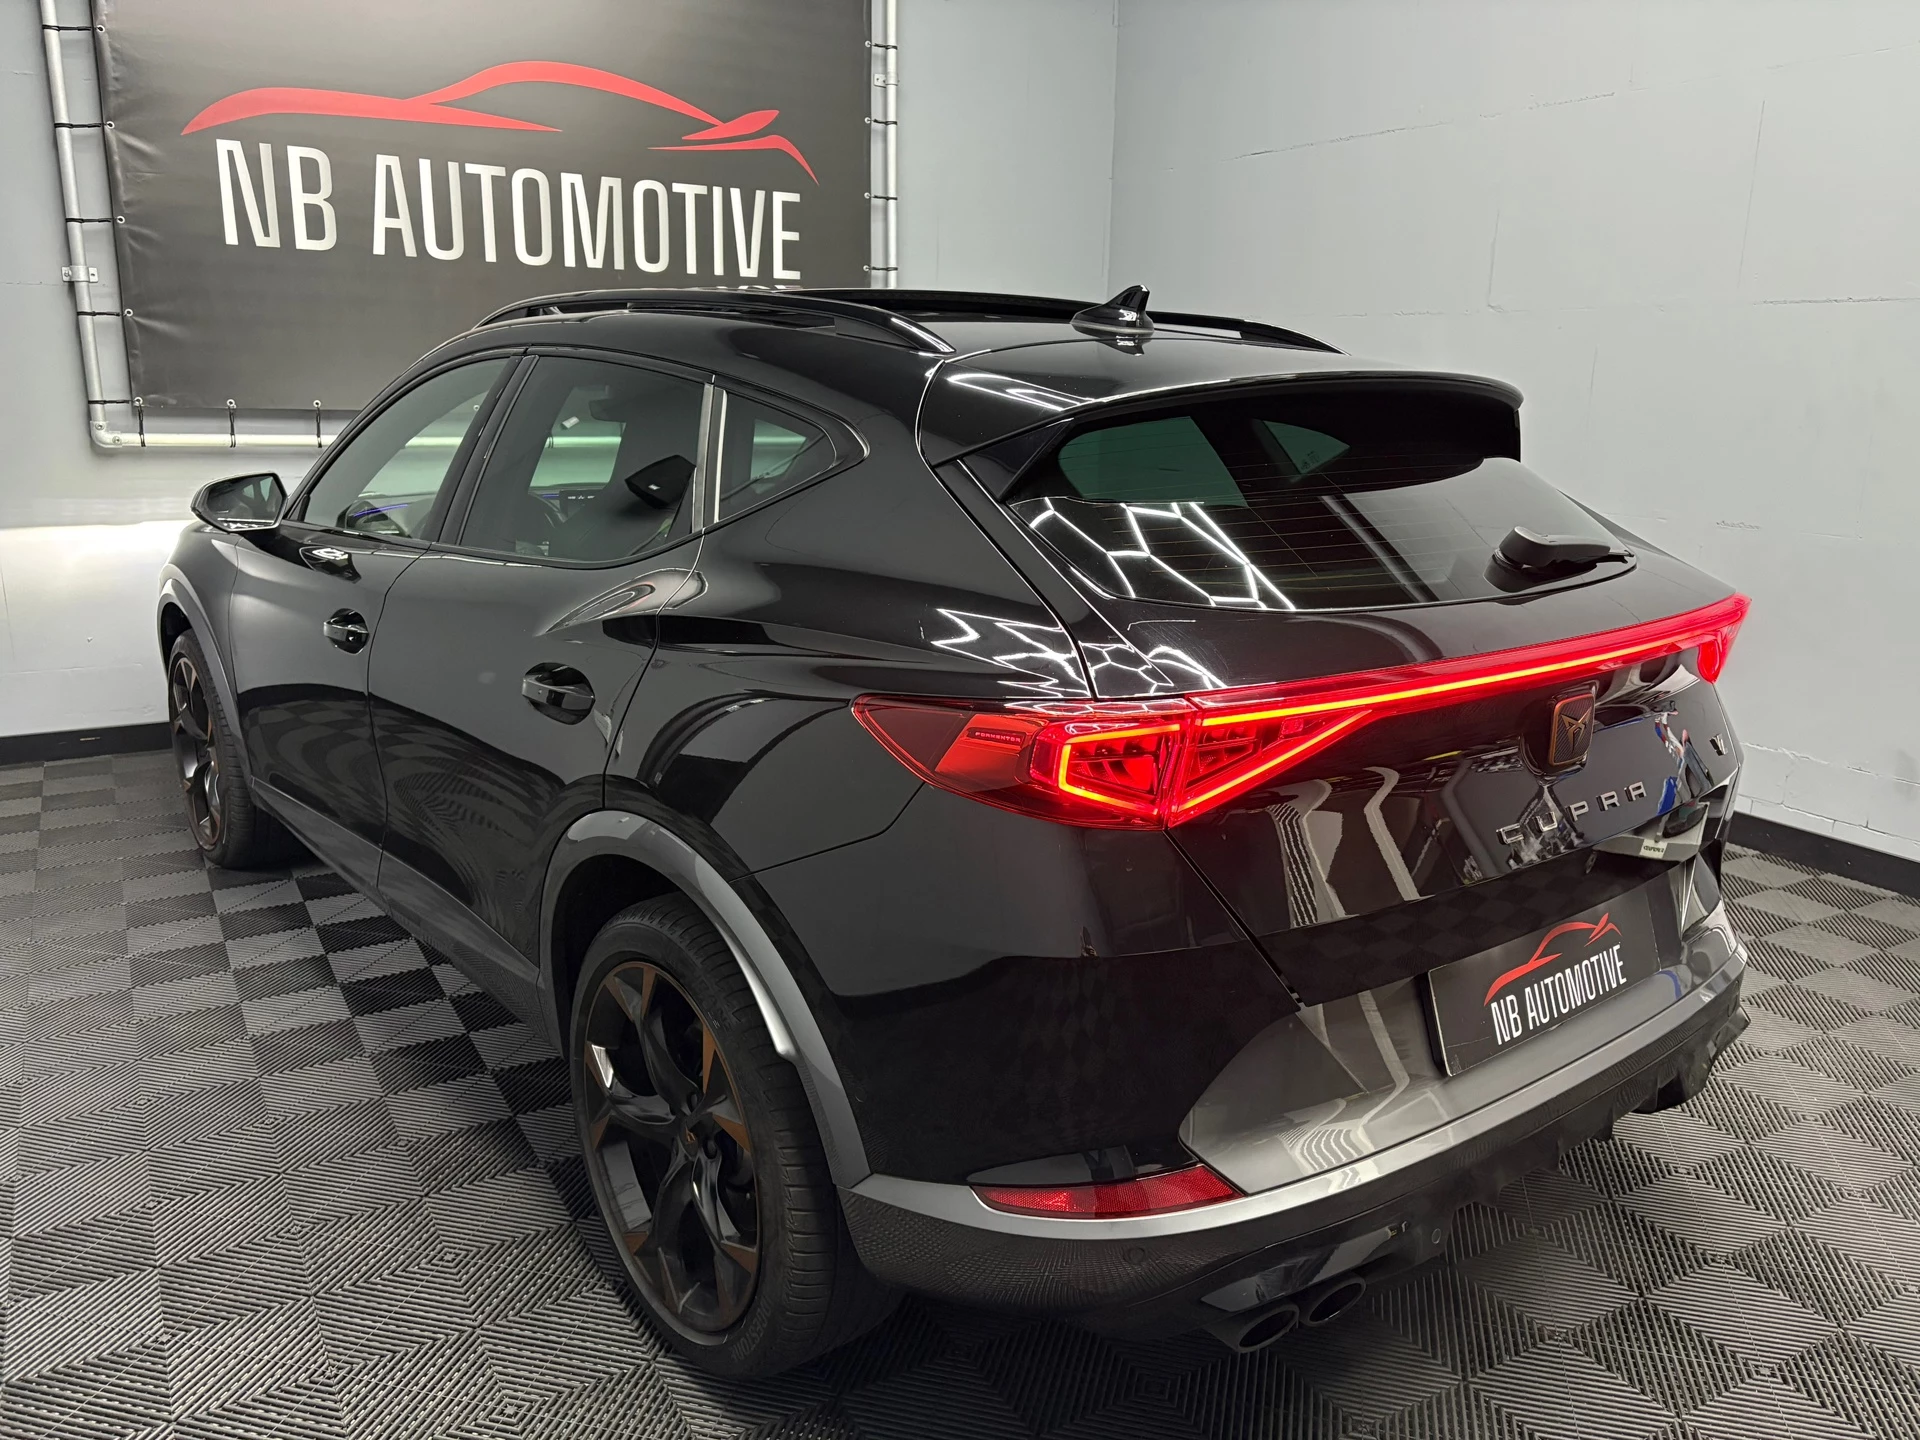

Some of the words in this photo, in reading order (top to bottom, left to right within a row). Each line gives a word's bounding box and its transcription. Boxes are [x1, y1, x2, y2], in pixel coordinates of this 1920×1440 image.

[216, 138, 337, 251] NB
[373, 153, 801, 280] AUTOMOTIVE
[974, 731, 1021, 743] FORMENTOR
[1497, 781, 1647, 844] CUPRA
[1490, 994, 1523, 1045] NB
[1524, 943, 1627, 1031] AUTOMOTIVE
